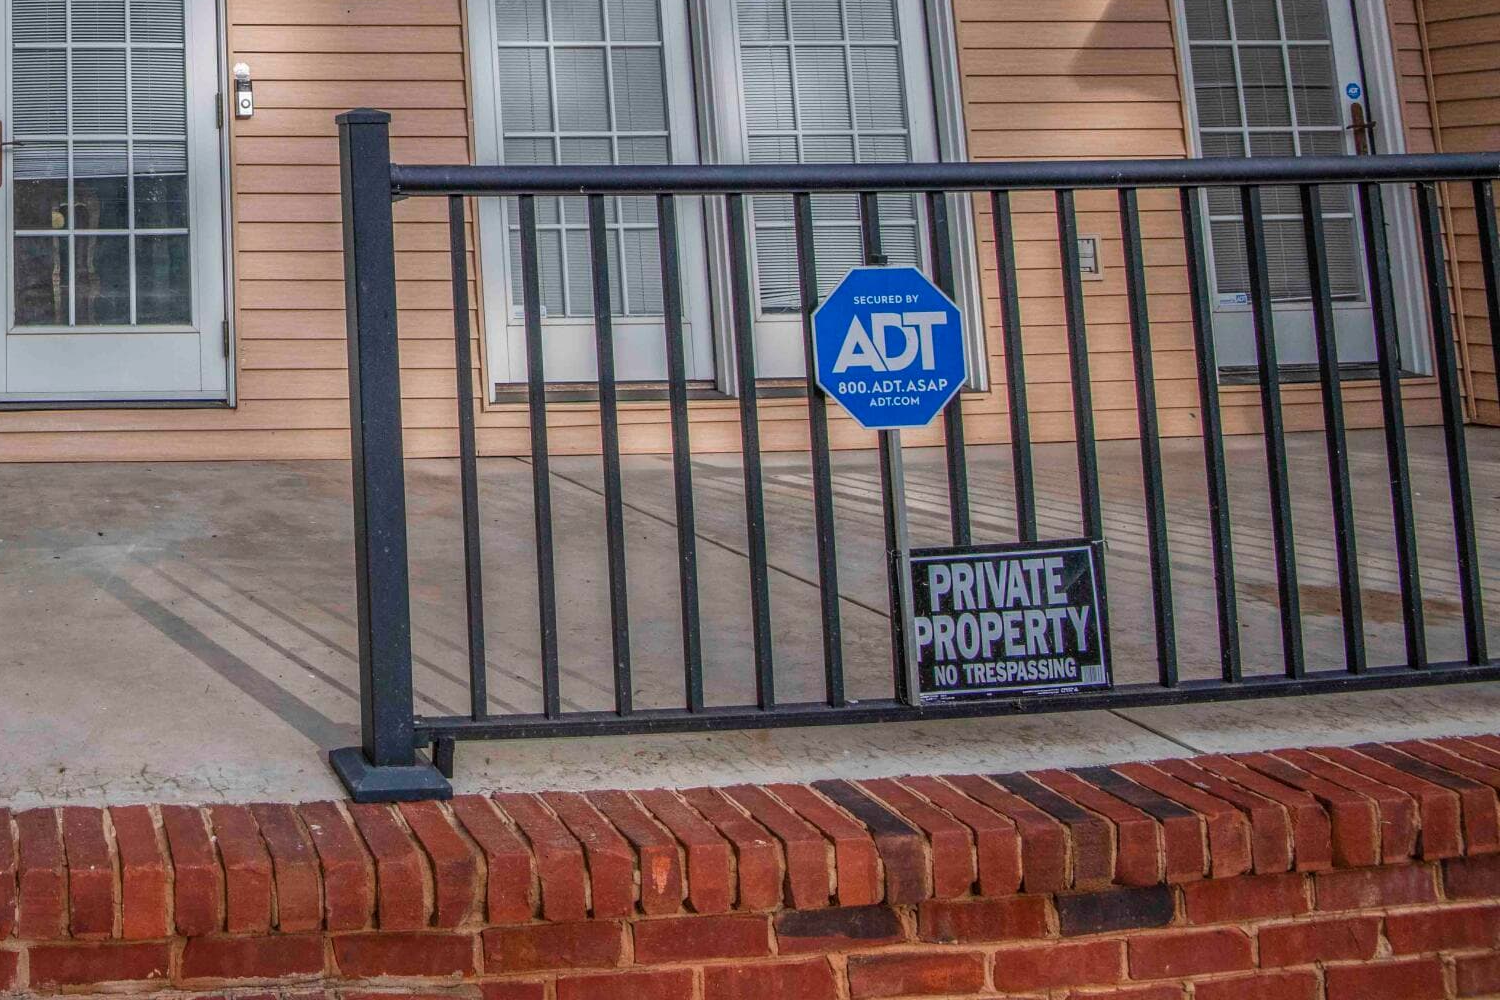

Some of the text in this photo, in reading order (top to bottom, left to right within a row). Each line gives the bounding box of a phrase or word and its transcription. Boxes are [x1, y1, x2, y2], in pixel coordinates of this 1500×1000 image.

[853, 295, 919, 305] SECURED BY
[832, 311, 948, 373] ADT
[838, 379, 948, 394] 800.ADT.ASAP
[870, 397, 920, 407] ADT.COM
[928, 557, 1068, 611] PRIVATE
[915, 606, 1091, 662] PROPERTY
[933, 657, 1077, 686] NO TRESPASSING
